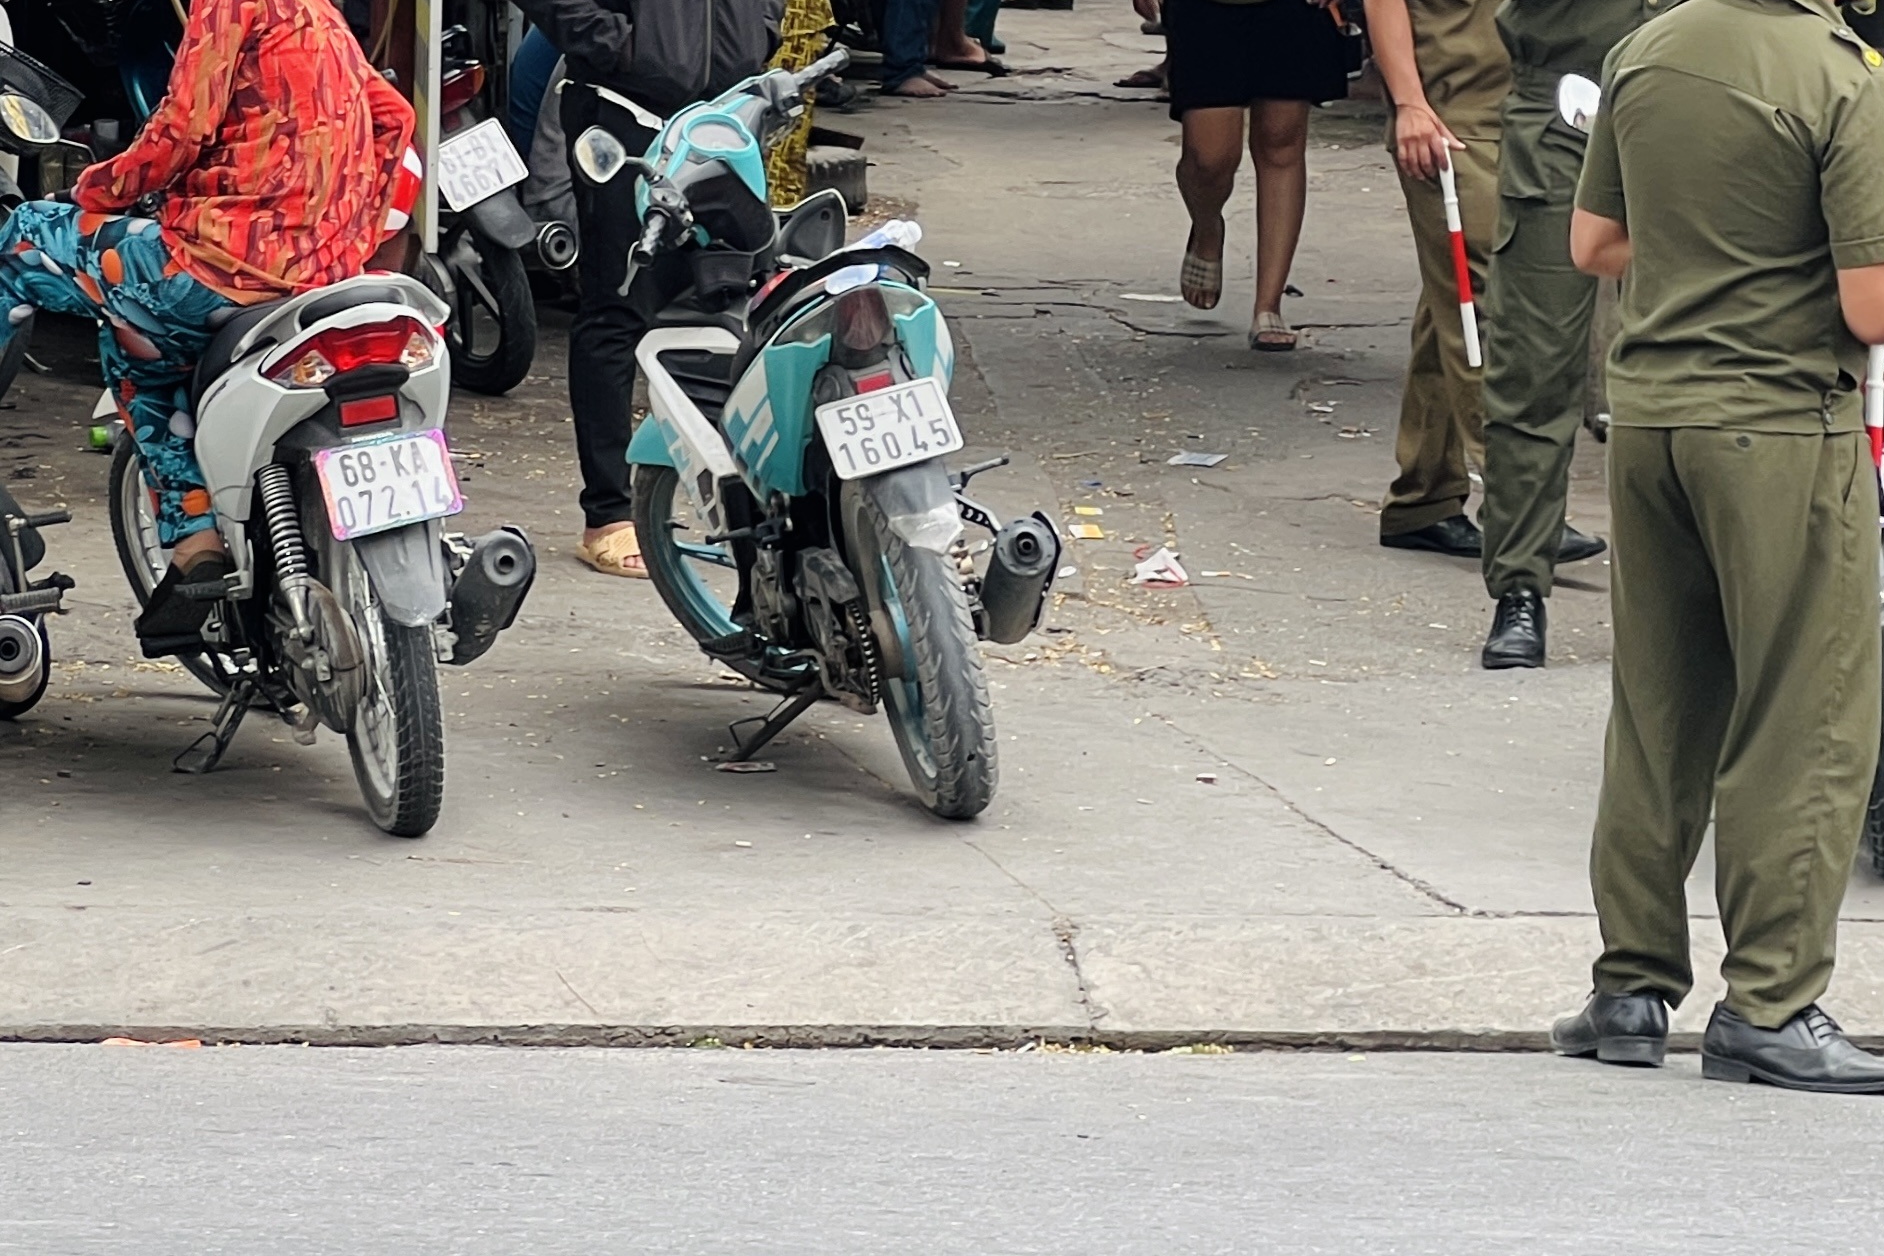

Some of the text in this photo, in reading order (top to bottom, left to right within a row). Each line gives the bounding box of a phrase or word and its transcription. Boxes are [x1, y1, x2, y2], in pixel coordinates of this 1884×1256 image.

[338, 441, 429, 487] 68-KA
[838, 417, 951, 471] 160.45
[337, 476, 450, 530] 072.14
